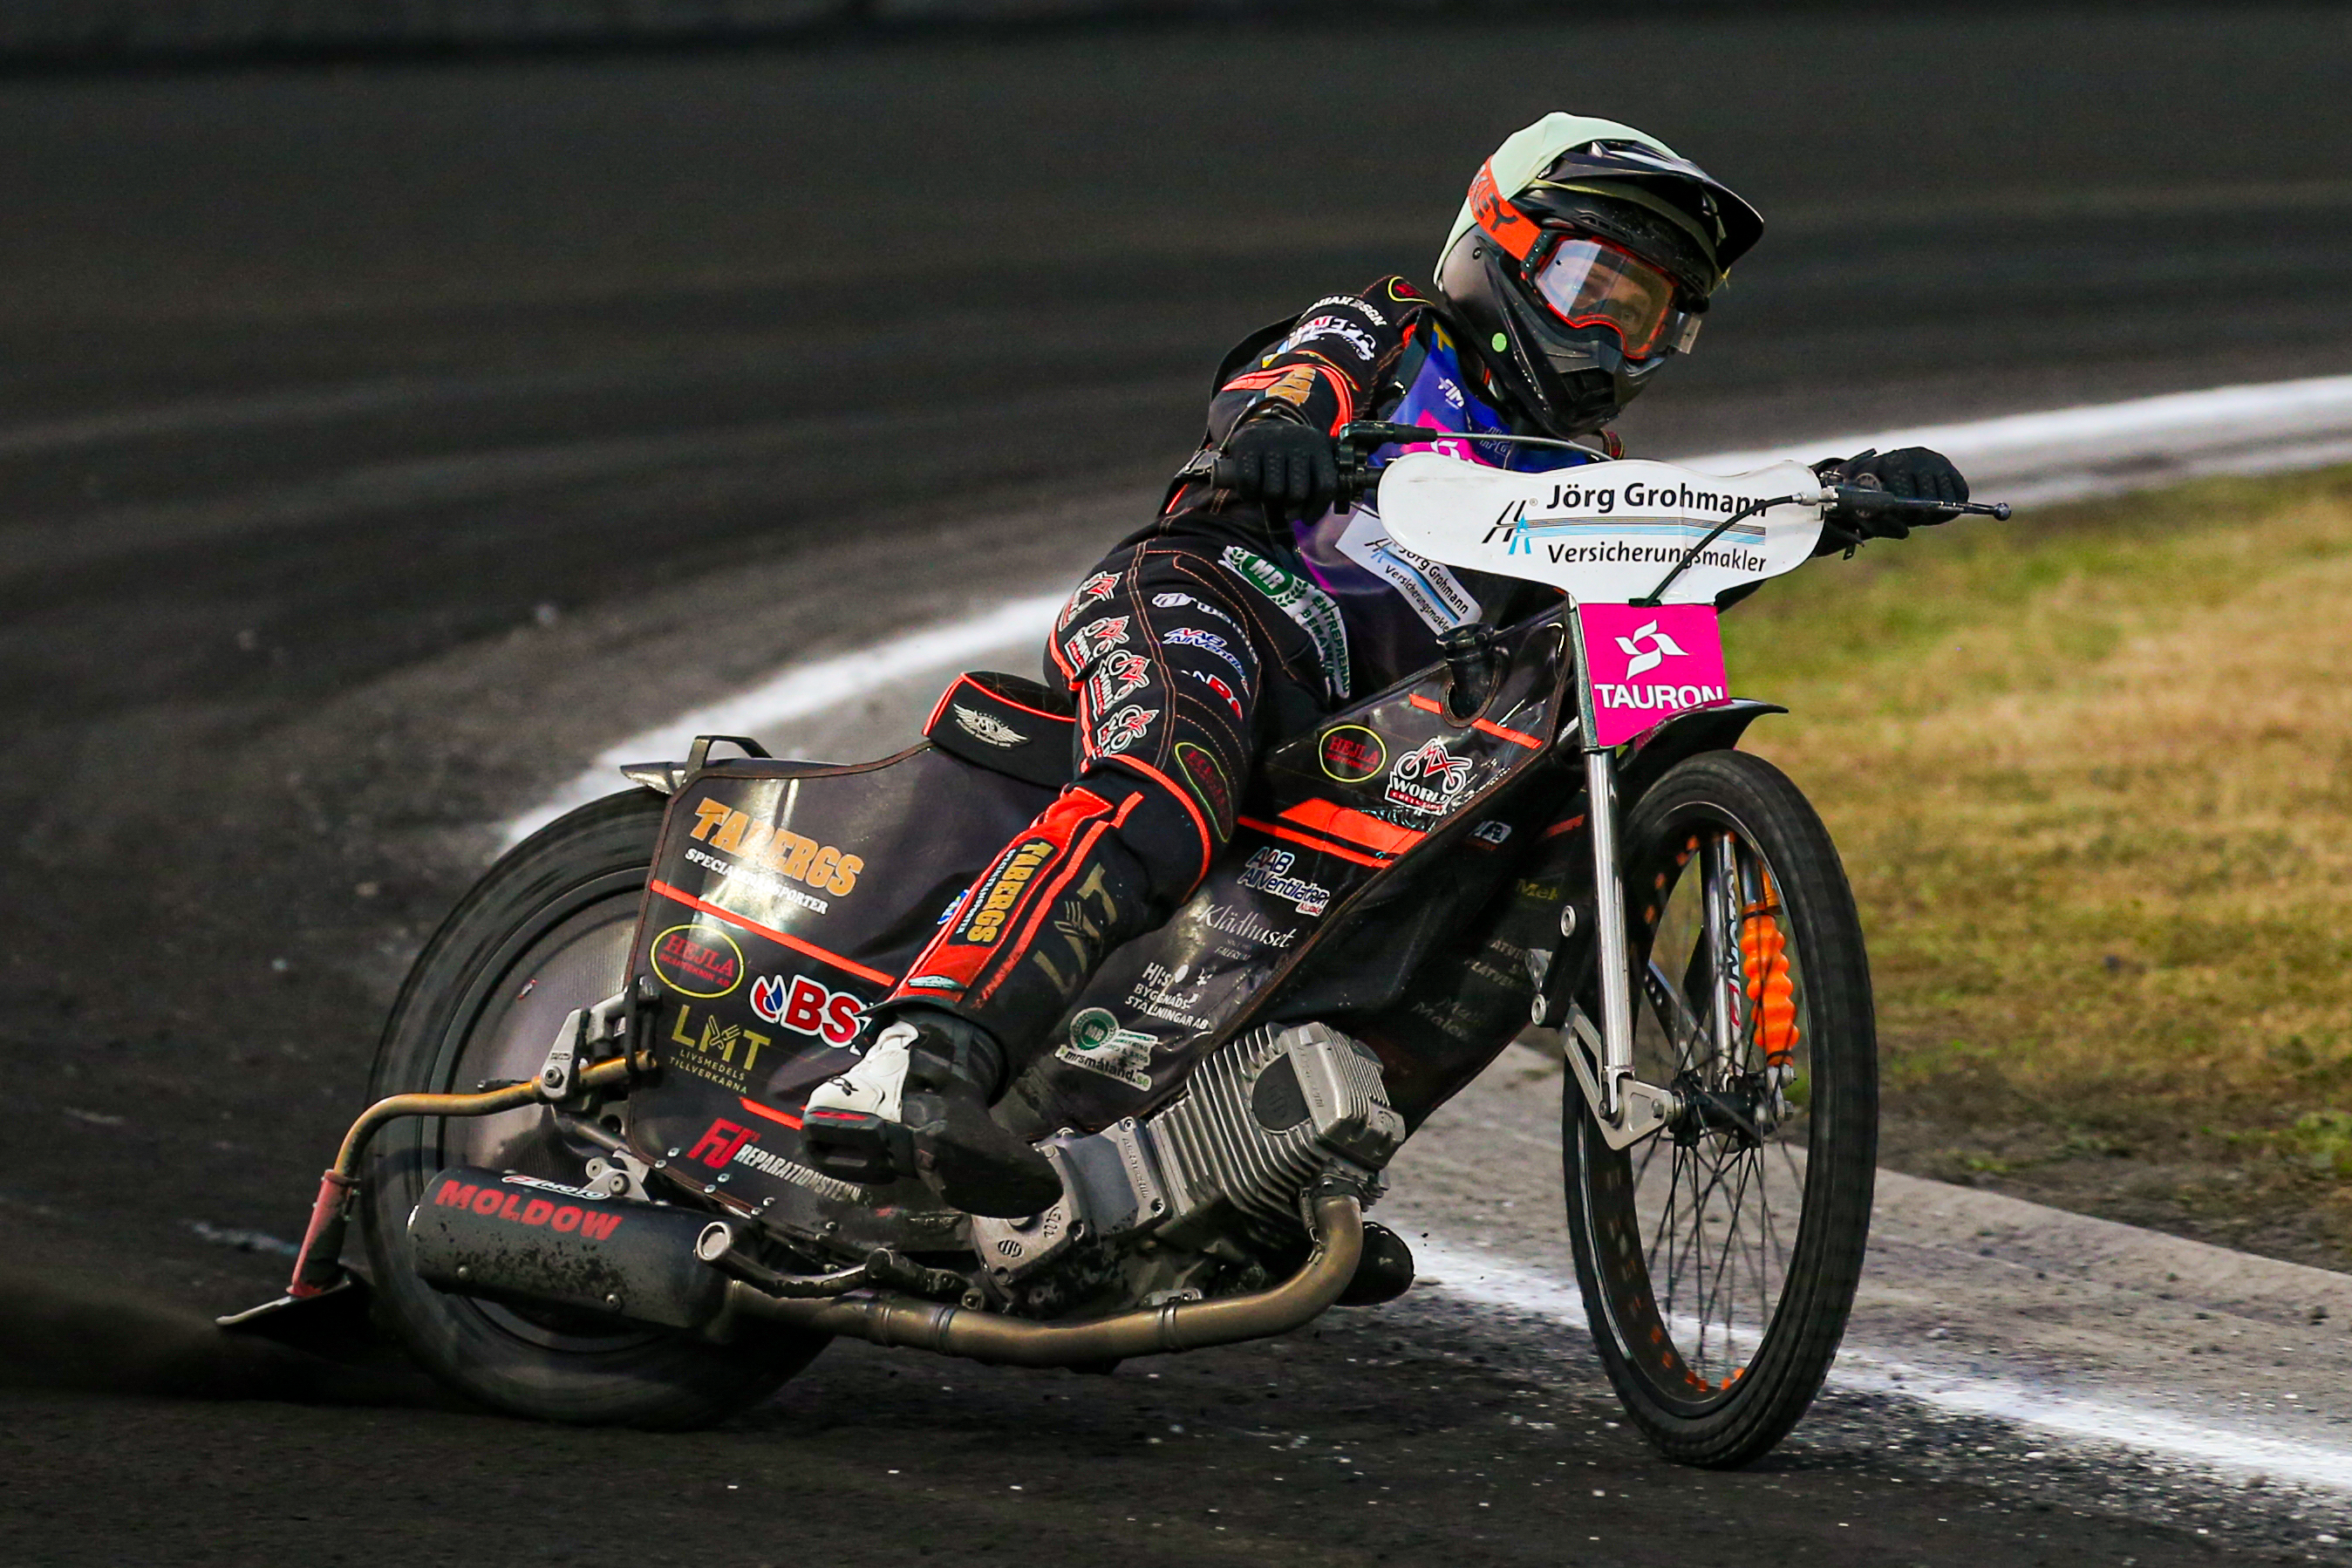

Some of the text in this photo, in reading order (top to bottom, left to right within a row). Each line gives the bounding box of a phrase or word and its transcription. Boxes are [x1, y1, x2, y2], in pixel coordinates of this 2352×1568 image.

[1546, 482, 1767, 517] Jörg Grohmann
[1249, 559, 1286, 590] MR
[1548, 541, 1767, 572] Versicherungsmakler
[1385, 565, 1449, 632] Versicherungsmakle
[1428, 566, 1469, 614] Grohmann
[1594, 684, 1725, 710] TAURON
[1245, 846, 1296, 876] AAB
[966, 842, 1053, 942] TABERGS
[1196, 903, 1298, 948] Klädhuset
[664, 934, 735, 977] HEJLA
[1192, 1017, 1210, 1030] AB
[670, 1056, 747, 1094] TILLVERKARNA
[679, 1049, 746, 1081] LIVSMEDELS
[435, 1179, 624, 1241] MOLDOW
